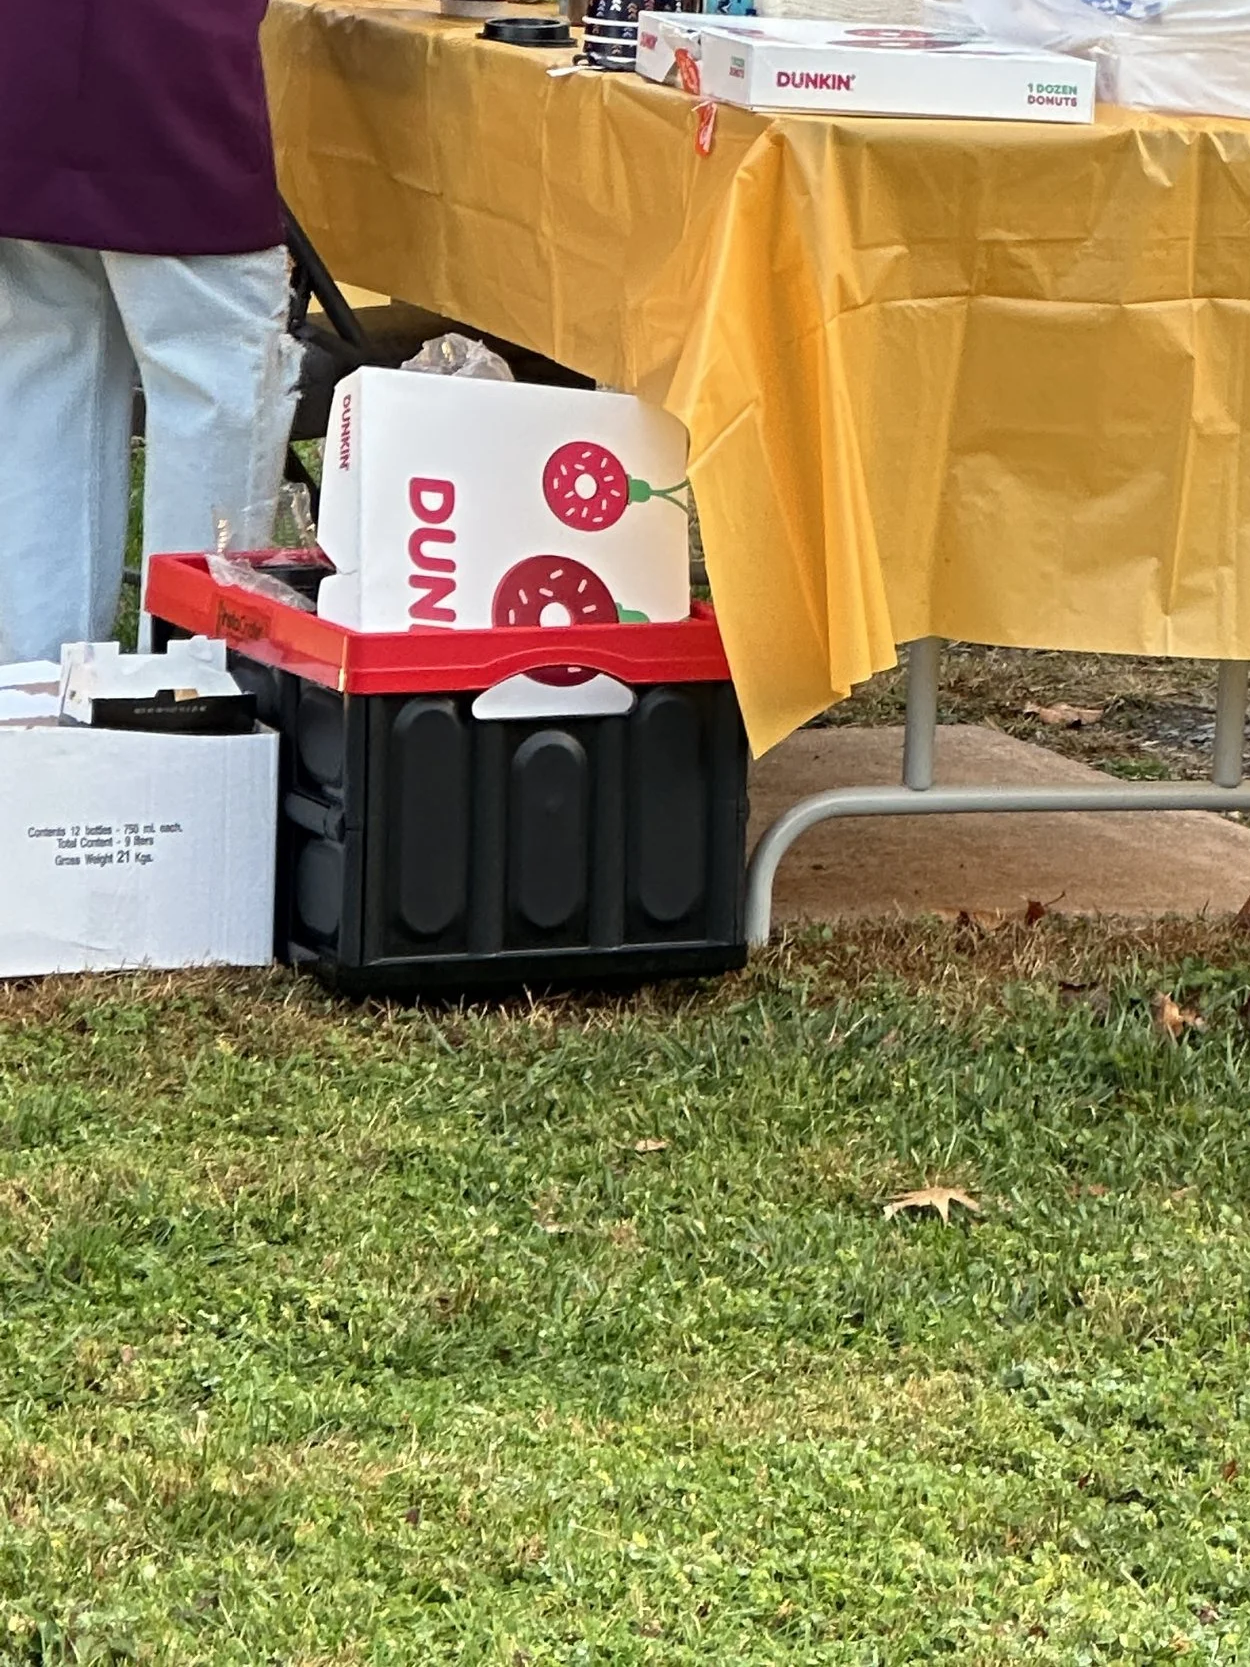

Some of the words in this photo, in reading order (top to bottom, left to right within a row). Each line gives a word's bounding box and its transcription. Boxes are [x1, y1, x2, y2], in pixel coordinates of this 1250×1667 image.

[776, 71, 857, 91] DUNKIN'
[1027, 83, 1033, 93] 1
[1036, 84, 1078, 95] DOZEN
[1027, 94, 1078, 107] DONUTS
[408, 477, 457, 632] DUN
[28, 827, 66, 838] Contents
[71, 826, 80, 836] 12
[85, 825, 112, 835] bottles
[124, 824, 139, 834] 750
[57, 838, 77, 848] Total
[80, 837, 113, 848] Content
[124, 836, 131, 847] 9
[55, 855, 80, 866] Gross
[85, 853, 113, 867] Weight
[117, 850, 130, 863] 21
